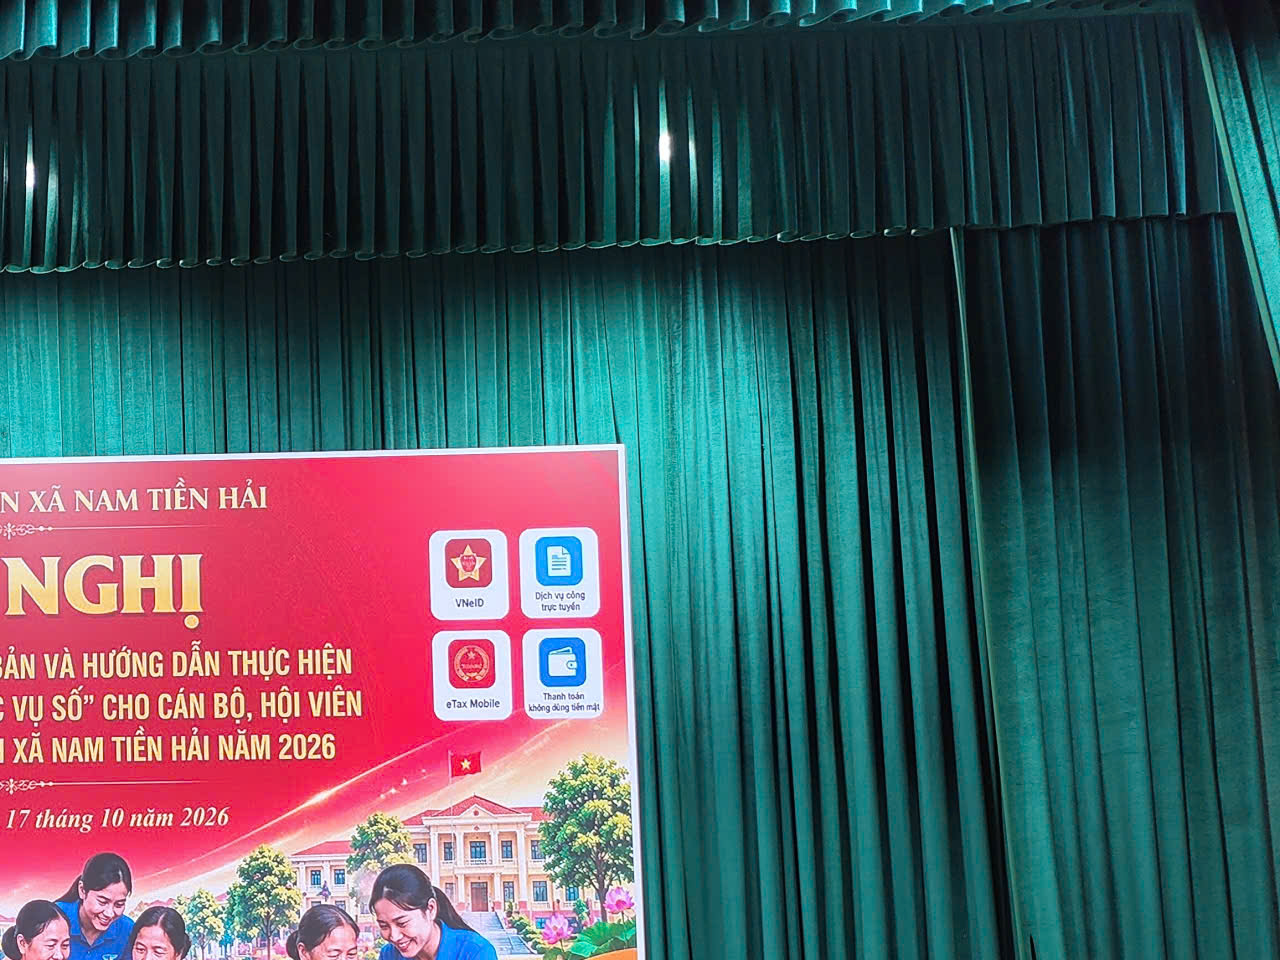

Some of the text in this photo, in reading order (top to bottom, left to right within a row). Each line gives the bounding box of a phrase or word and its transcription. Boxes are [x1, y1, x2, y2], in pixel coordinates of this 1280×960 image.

[28, 484, 66, 513] XÃ
[74, 489, 139, 512] NAM
[146, 477, 209, 511] TIỀN
[218, 479, 267, 509] HẢI
[0, 554, 204, 629] NGHỊ
[455, 598, 484, 608] VNeID
[535, 590, 586, 602] Dịch vụ công
[44, 647, 75, 679] VÀ
[83, 645, 164, 679] HƯỚNG
[173, 640, 220, 678] DẪN
[228, 648, 290, 681] THỰC
[298, 643, 352, 680] HIỆN
[12, 695, 44, 727] VỤ
[52, 685, 94, 722] SỐ”
[102, 693, 150, 721] CHO
[158, 687, 204, 720] CÁN
[213, 686, 252, 724] BỘ,
[261, 686, 300, 724] HỘI
[307, 685, 362, 718] VIÊN
[446, 698, 500, 709] eTax Mobile
[528, 703, 550, 713] không
[543, 691, 584, 701] Thanh toán
[12, 732, 44, 764] XÃ
[52, 736, 104, 763] NAM
[111, 725, 163, 762] TIỀN
[171, 727, 209, 762] HẢI
[218, 729, 271, 761] NĂM
[278, 733, 336, 760] 2026
[6, 809, 31, 829] 17
[35, 807, 93, 834] tháng
[101, 807, 125, 828] 10
[129, 808, 173, 828] năm
[179, 806, 231, 827] 2026
